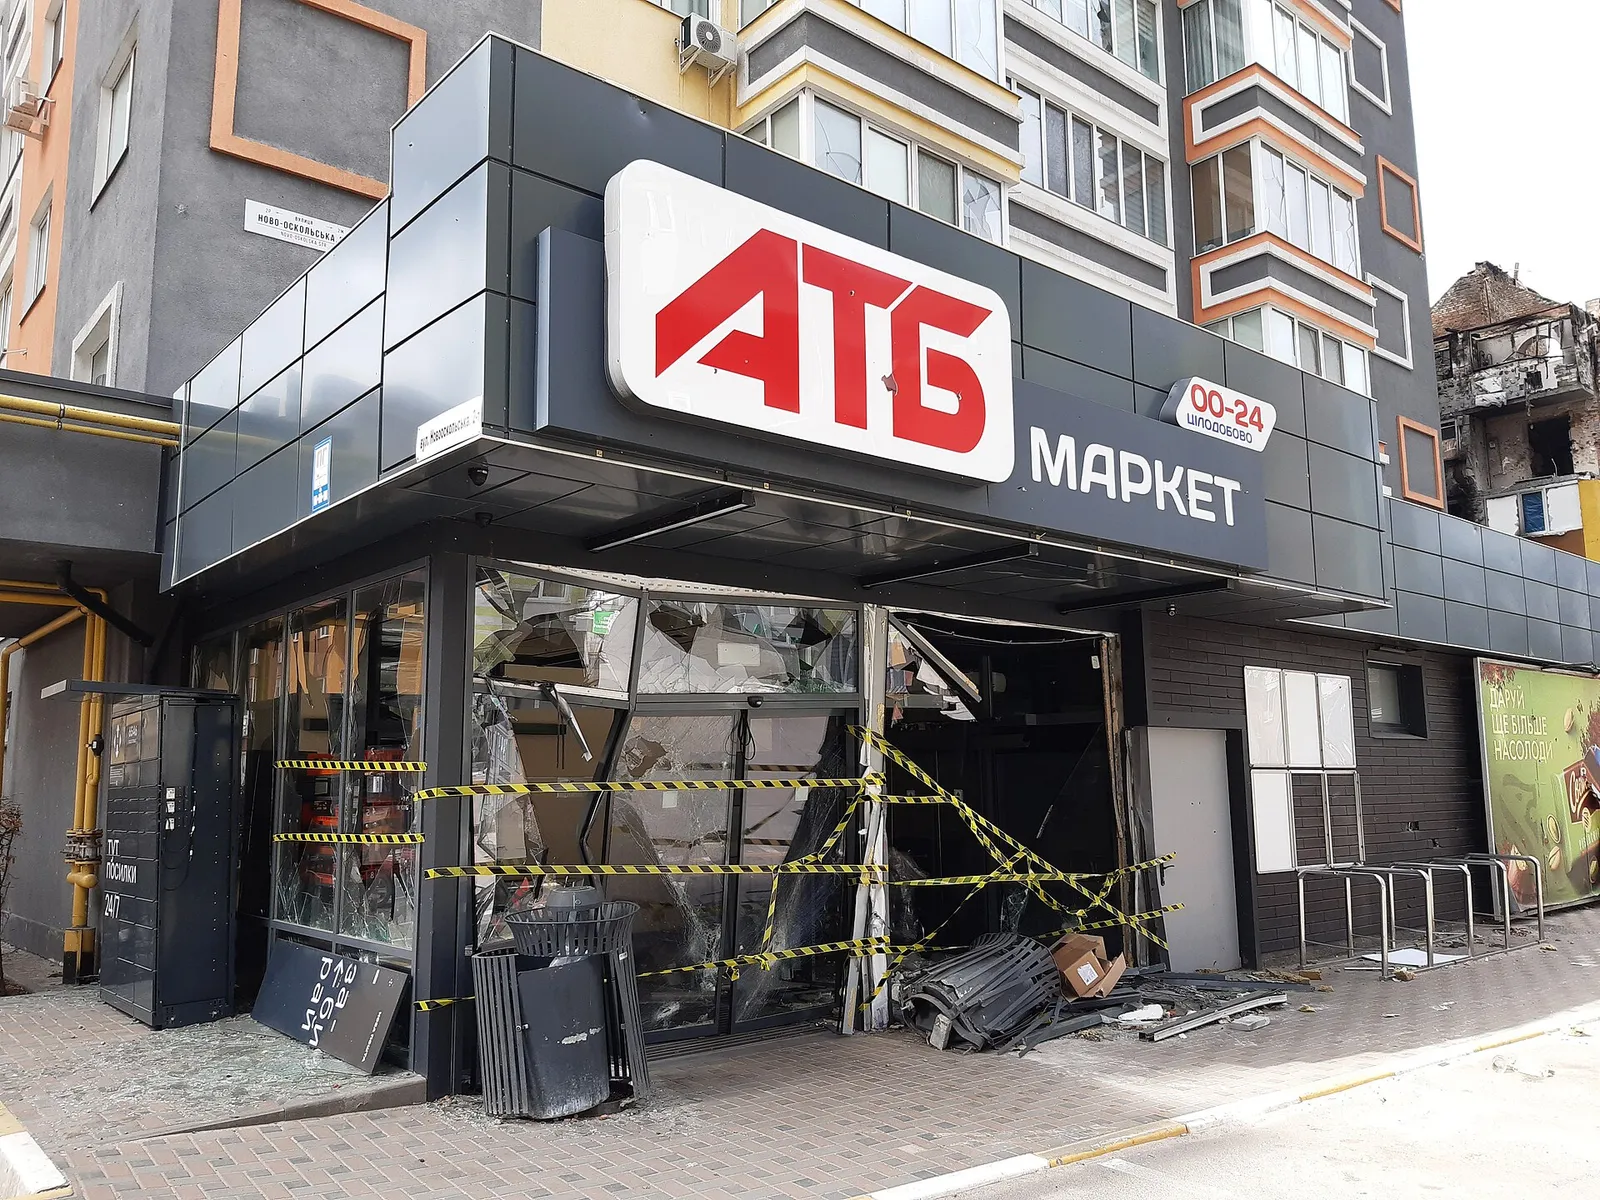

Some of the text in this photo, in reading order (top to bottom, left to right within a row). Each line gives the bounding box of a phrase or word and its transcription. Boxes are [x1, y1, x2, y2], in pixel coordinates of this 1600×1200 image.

[258, 214, 335, 242] НОВО-ОСКОЛЬСЬКА
[655, 228, 993, 454] АТБ
[1190, 383, 1264, 432] 00-24
[1187, 412, 1253, 444] ЦІЛОДОБОВО
[1030, 426, 1241, 526] МАРКЕТ
[1490, 685, 1525, 712] ДАРУЙ
[1491, 714, 1548, 738] ЩЕ БІЛЬШЕ
[1494, 740, 1554, 764] НАСОЛОДИ
[104, 893, 120, 919] 24/7
